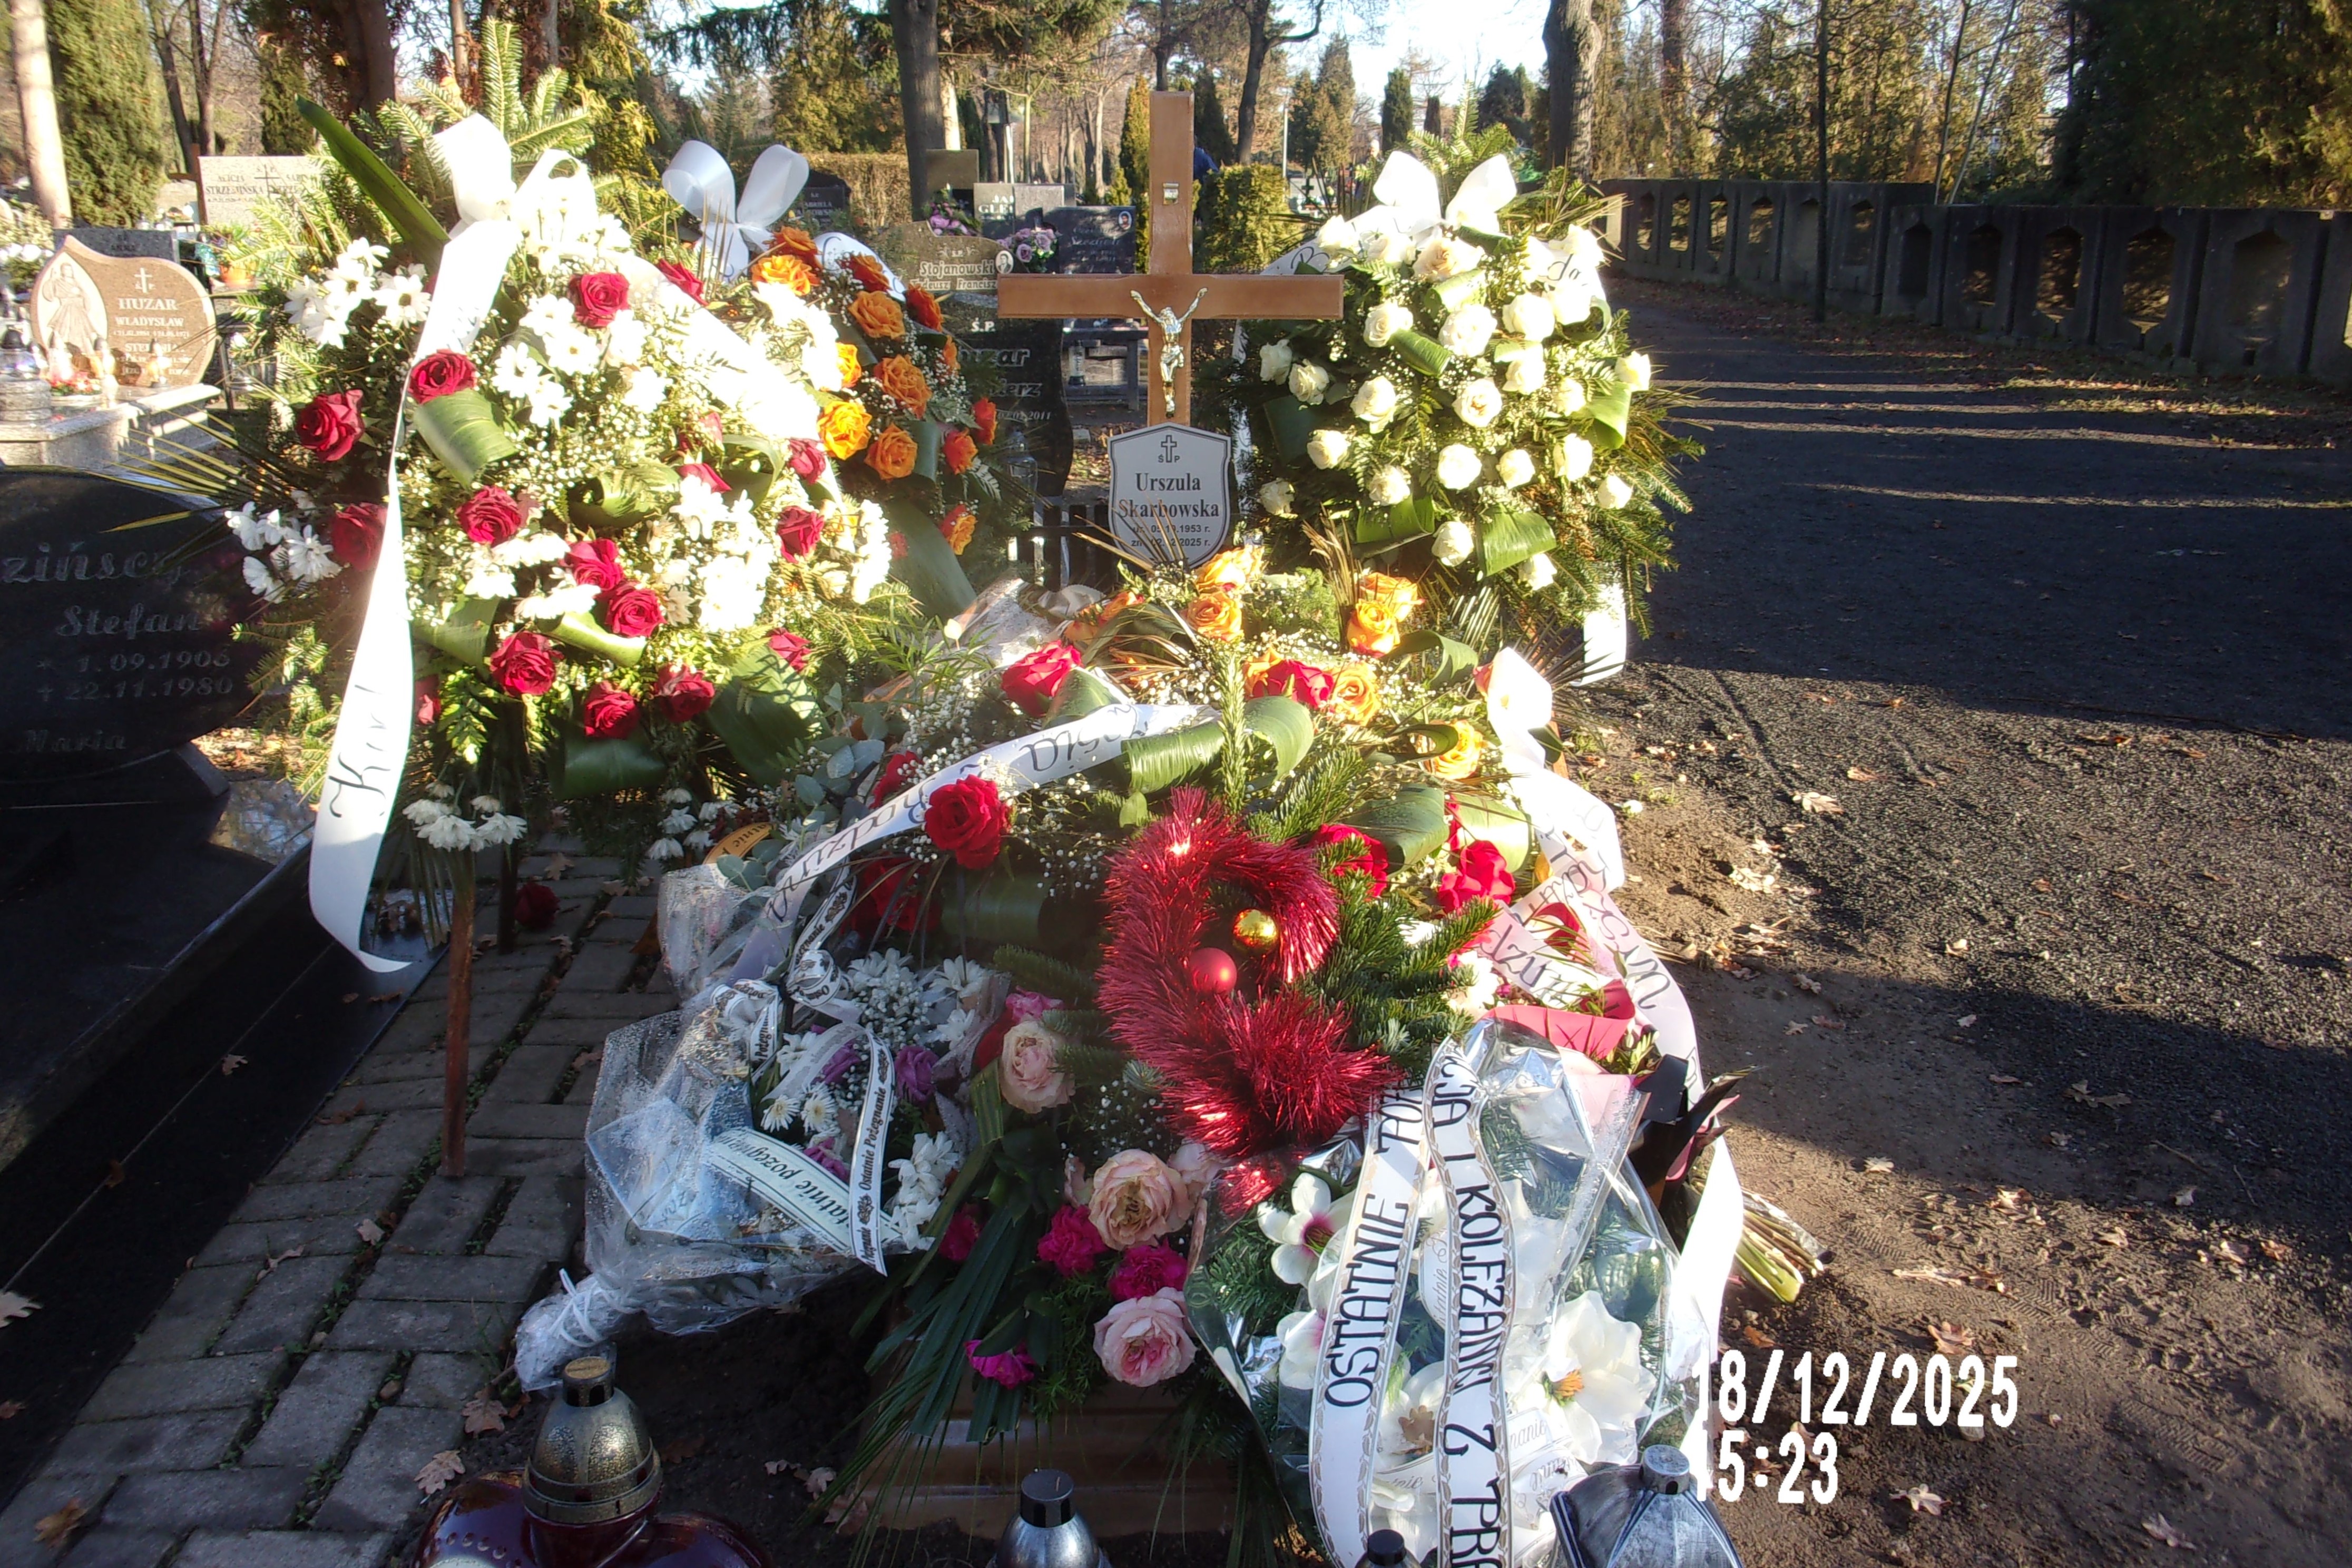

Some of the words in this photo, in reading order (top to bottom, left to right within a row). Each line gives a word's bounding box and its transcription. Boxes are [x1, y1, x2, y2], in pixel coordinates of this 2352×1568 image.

[919, 260, 995, 278] Stojanowski
[956, 277, 997, 290] Francisz
[118, 298, 180, 310] HUZAR
[971, 317, 996, 332] Ś.P.
[124, 342, 178, 352] STENIA
[1135, 473, 1201, 491] Urszula
[1119, 499, 1220, 518] Skarbowska
[56, 604, 201, 639] Stefan
[732, 823, 767, 848] atnie
[863, 1087, 887, 1149] Pożegnanie
[859, 1149, 876, 1191] Ostatnie
[1324, 1193, 1410, 1407] OSTATNIE
[1443, 1423, 1496, 1458] Z
